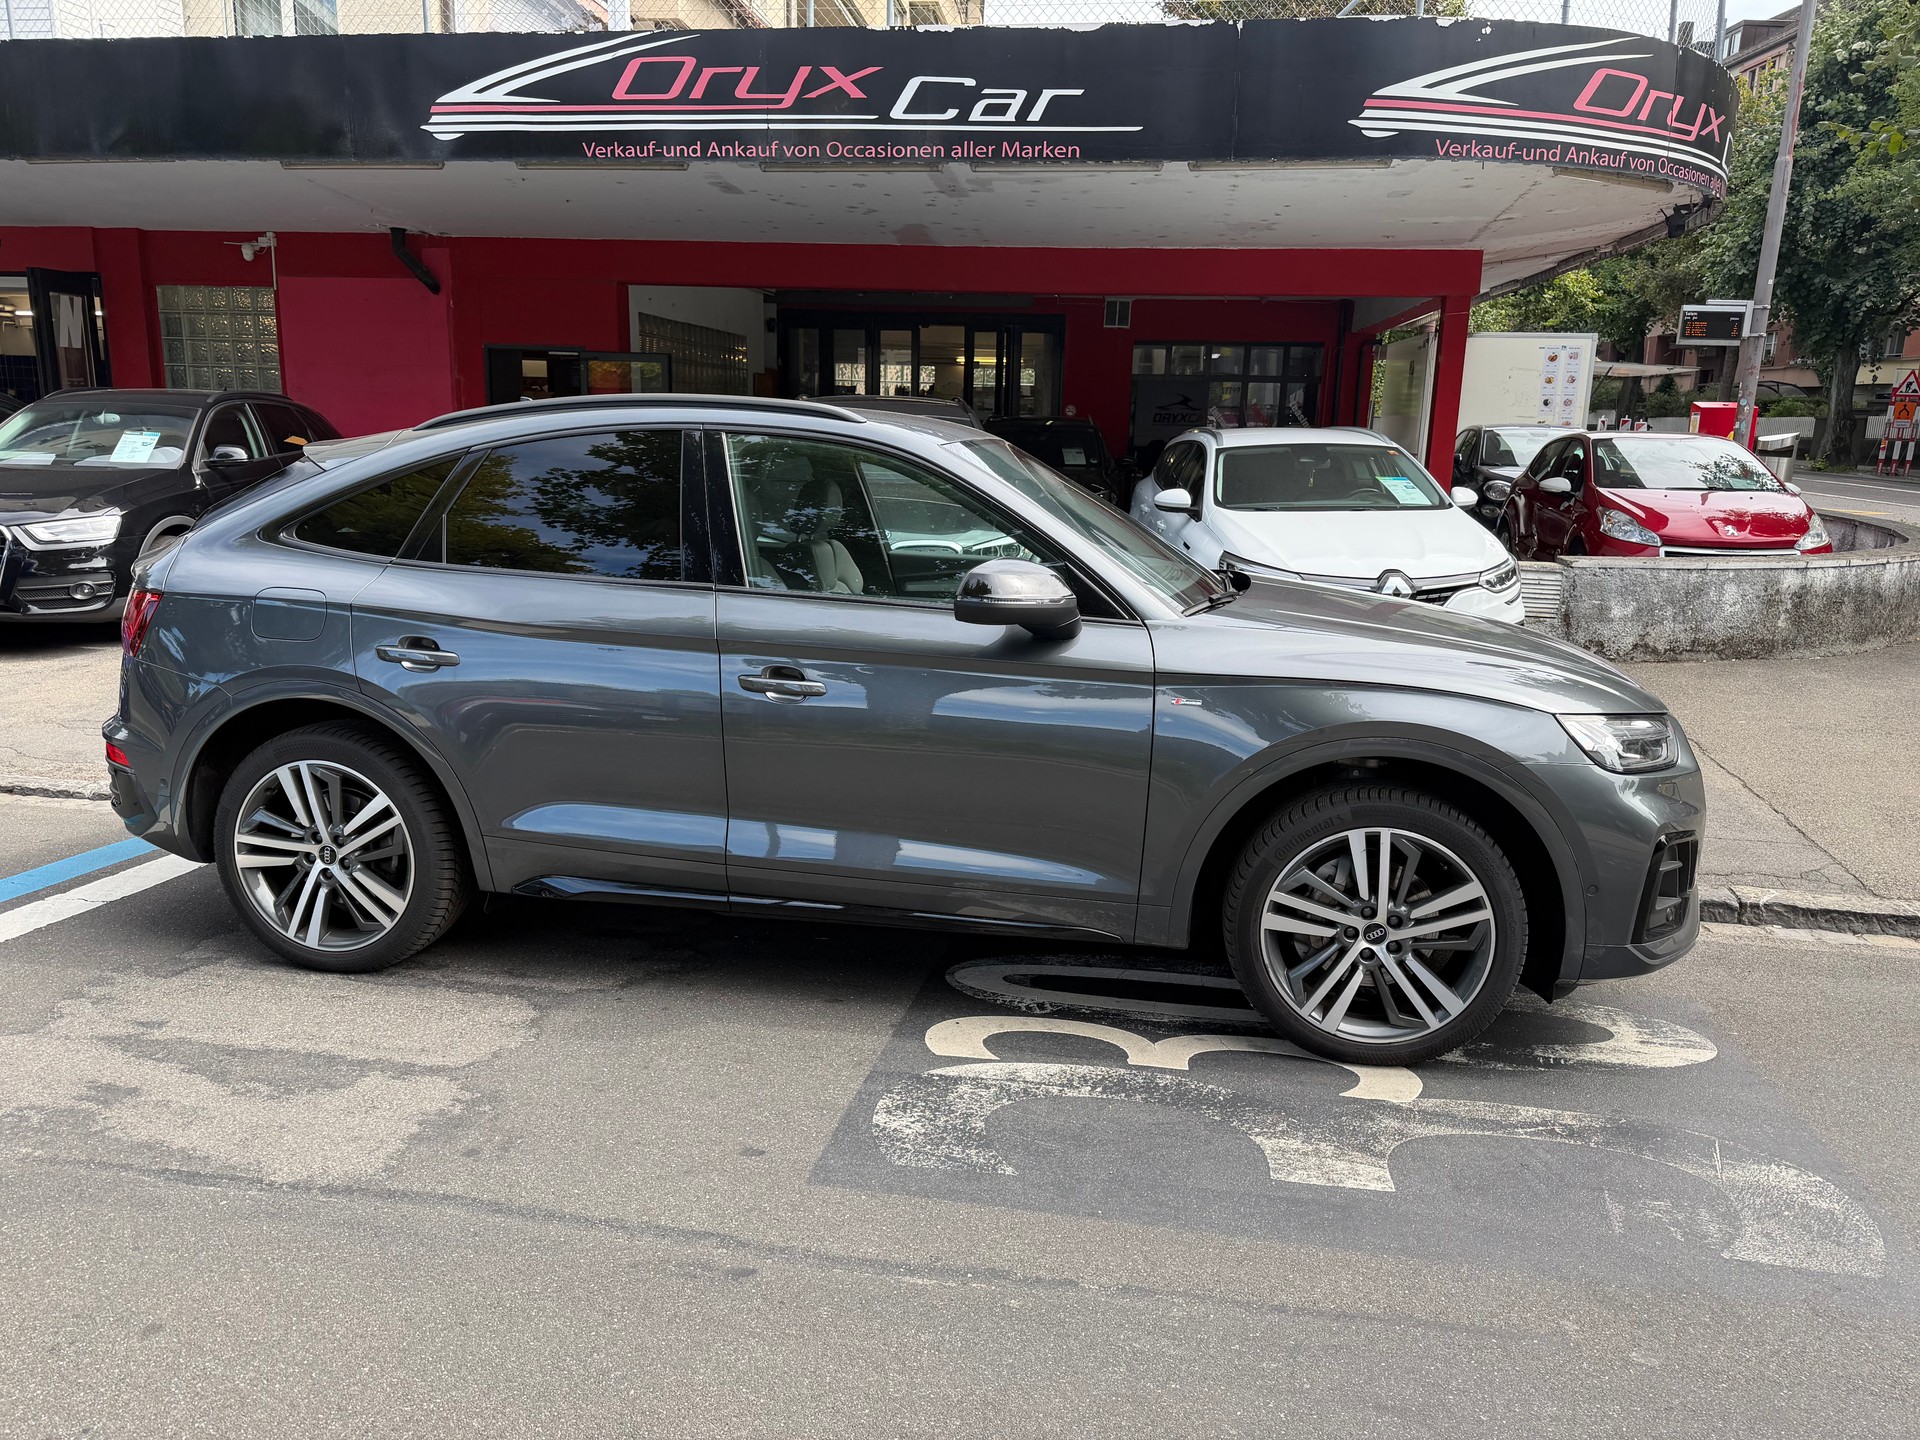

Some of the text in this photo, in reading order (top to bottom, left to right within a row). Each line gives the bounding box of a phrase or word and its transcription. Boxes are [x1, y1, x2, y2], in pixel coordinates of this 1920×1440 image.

[611, 56, 1086, 122] Oryx Car
[1572, 67, 1727, 144] Oryx
[582, 140, 1081, 159] Verkauf-und Ankauf von Occasionen aller Marken
[1435, 138, 1562, 163] Verkauf-und
[1564, 145, 1628, 169] Ankauf
[1629, 156, 1655, 173] von
[1658, 157, 1710, 187] Occasionen
